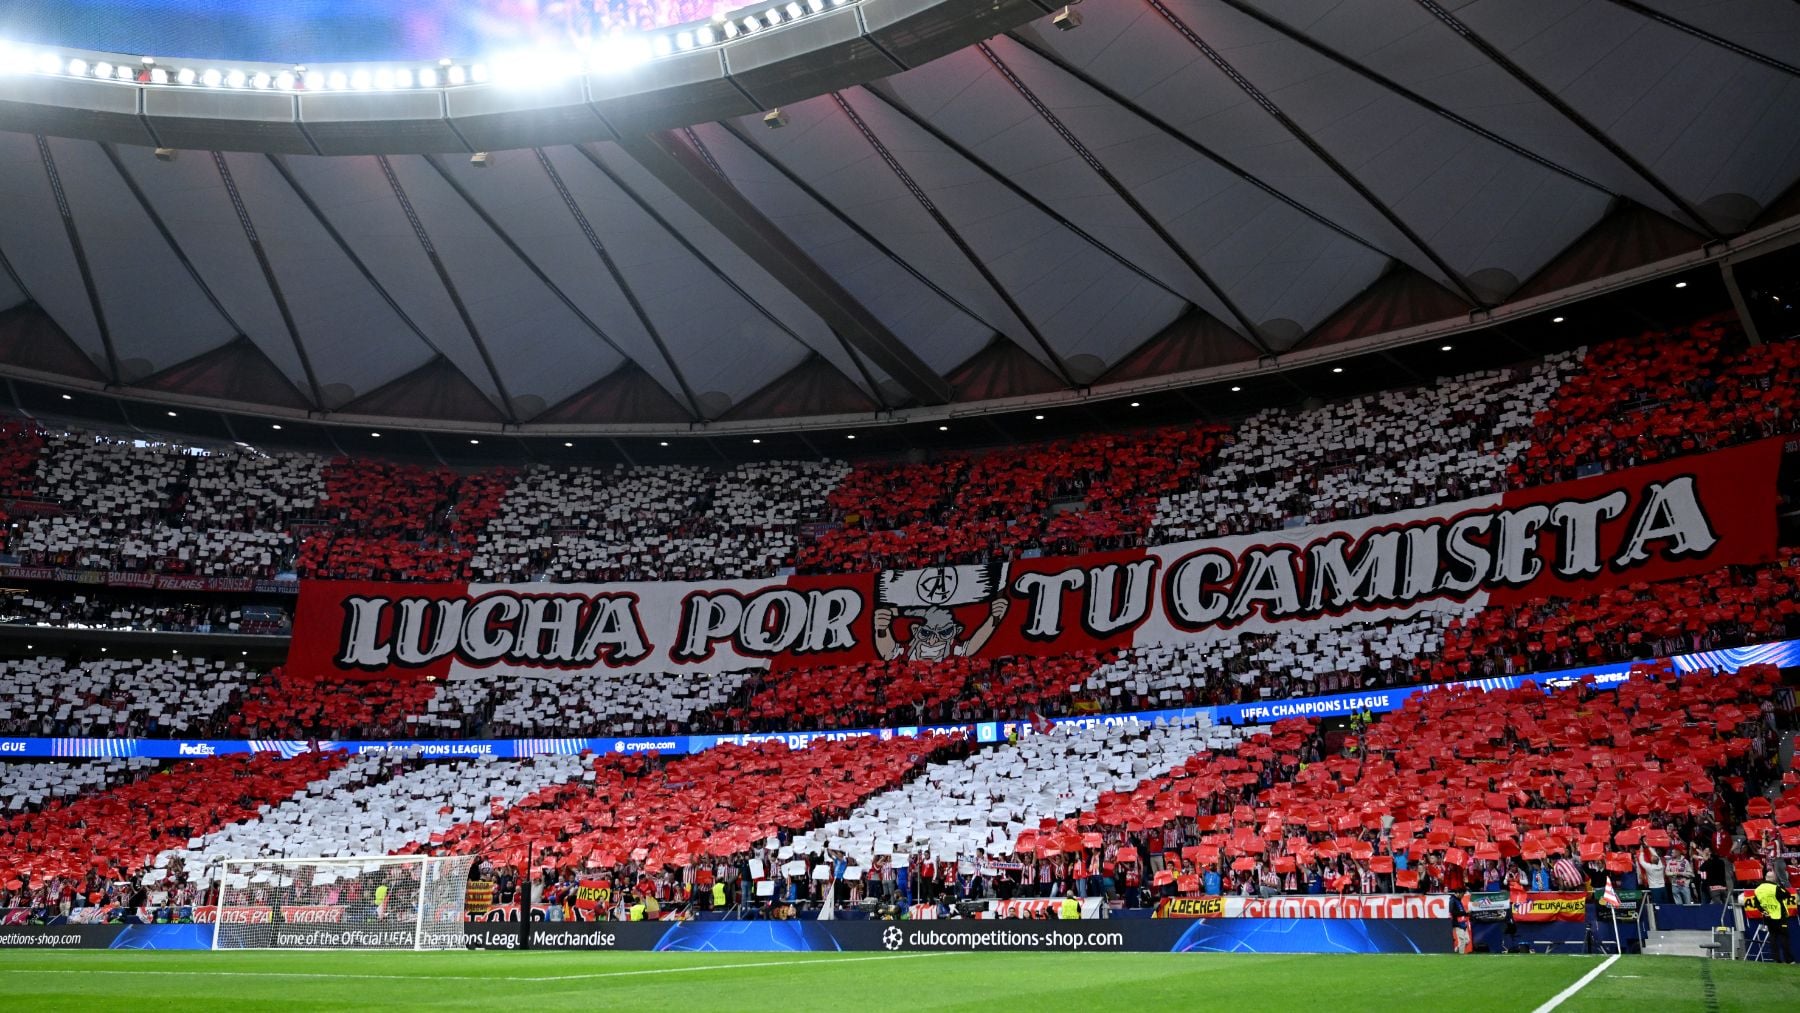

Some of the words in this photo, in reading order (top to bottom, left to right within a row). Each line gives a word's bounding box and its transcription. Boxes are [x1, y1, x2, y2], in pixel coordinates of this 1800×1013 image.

[341, 592, 651, 666] LUCHA
[677, 588, 863, 657] POR
[1012, 558, 1156, 637] TU
[1170, 475, 1718, 623] CAMISETA
[158, 578, 204, 590] TIELMES
[1272, 700, 1341, 717] CHAMPIONS
[1343, 695, 1389, 709] LEAGUE
[982, 726, 992, 740] 0
[0, 742, 26, 752] GUE
[179, 743, 215, 755] FedEx
[452, 744, 492, 754] LEAGUE
[626, 740, 676, 752] crypto.com
[788, 734, 809, 750] DE
[578, 887, 609, 901] MECO
[1171, 898, 1221, 914] LOECHES
[306, 930, 319, 945] of
[320, 930, 339, 945] the
[341, 930, 382, 945] Official
[533, 930, 616, 946] Merchandise
[909, 929, 1124, 949] clubcompetitions-shop.com
